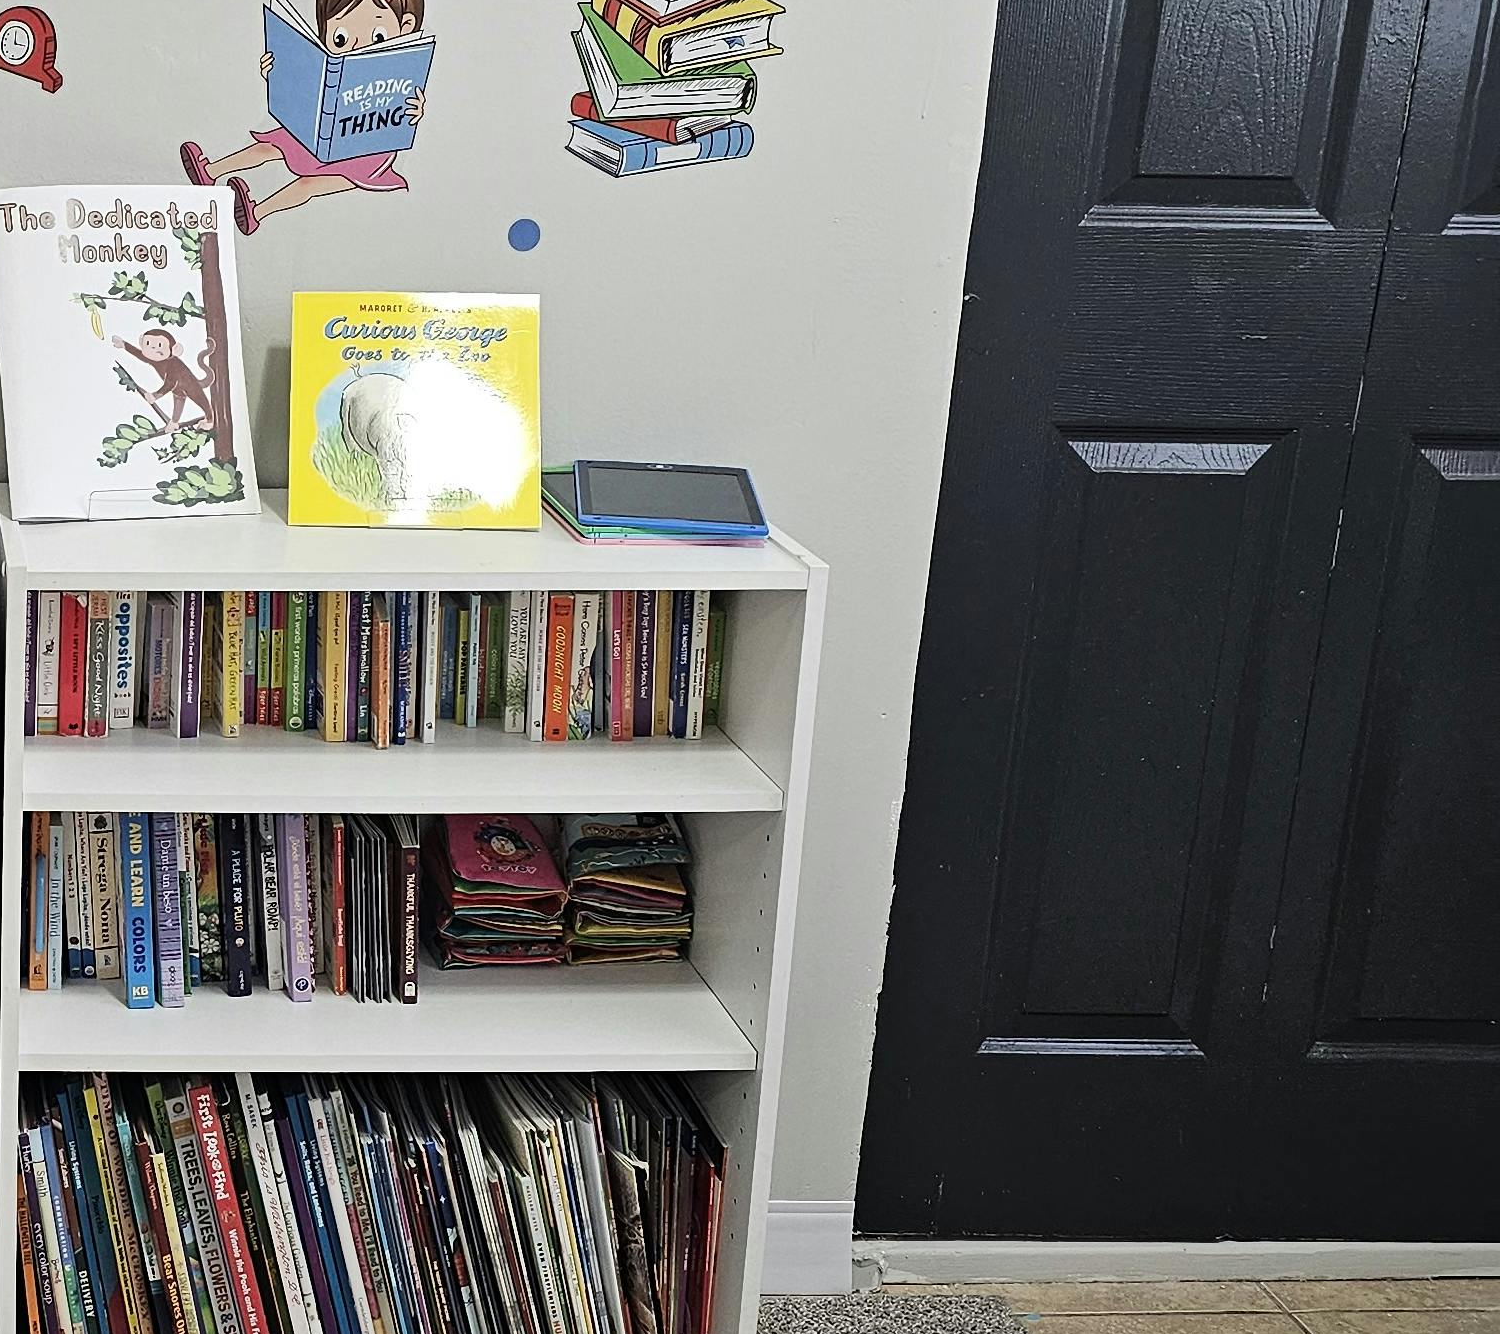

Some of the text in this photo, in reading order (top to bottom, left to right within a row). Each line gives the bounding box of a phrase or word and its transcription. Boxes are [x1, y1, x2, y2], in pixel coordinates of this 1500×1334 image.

[342, 79, 413, 106] READING
[360, 97, 394, 112] IS MY
[339, 106, 406, 137] THING
[66, 198, 218, 230] Dedicated
[58, 233, 168, 269] Monkey
[324, 316, 509, 345] Curious George
[341, 346, 383, 361] Goes
[390, 347, 411, 361] to
[361, 602, 371, 623] Last
[113, 602, 133, 689] opposites
[359, 625, 371, 683] Marshmallow
[91, 620, 104, 716] Kiss Good Night
[552, 625, 565, 713] GOODNIGHT MOON
[358, 704, 367, 718] Lin
[128, 822, 144, 907] AND LEARN
[159, 838, 174, 913] Dame un beso
[231, 858, 241, 884] PLACE
[92, 837, 113, 943] Strega Nona
[232, 887, 243, 904] FOR
[264, 875, 276, 898] BEAR
[48, 878, 60, 937] In the Wind
[233, 905, 244, 932] PLUTO
[266, 901, 279, 931] ROMP!
[404, 872, 415, 974] THANKFUL THANKSGIVING
[131, 916, 146, 973] COLORS
[131, 985, 149, 997] KB
[19, 1143, 35, 1174] Hurley
[193, 1092, 217, 1129] First
[210, 1169, 232, 1201] Find
[176, 1138, 204, 1191] TREES,
[187, 1188, 217, 1250] LEAVES,
[350, 1169, 385, 1294] You Read to Me, I'll Read to You
[226, 1227, 243, 1258] Winnie
[31, 1221, 54, 1305] every color soup
[160, 1253, 176, 1281] Bear
[233, 1258, 246, 1274] the
[203, 1247, 232, 1313] FLOWERS
[237, 1273, 252, 1296] Pooh
[166, 1280, 184, 1320] Snores
[242, 1295, 256, 1312] and
[218, 1311, 235, 1325] &
[246, 1311, 260, 1327] His
